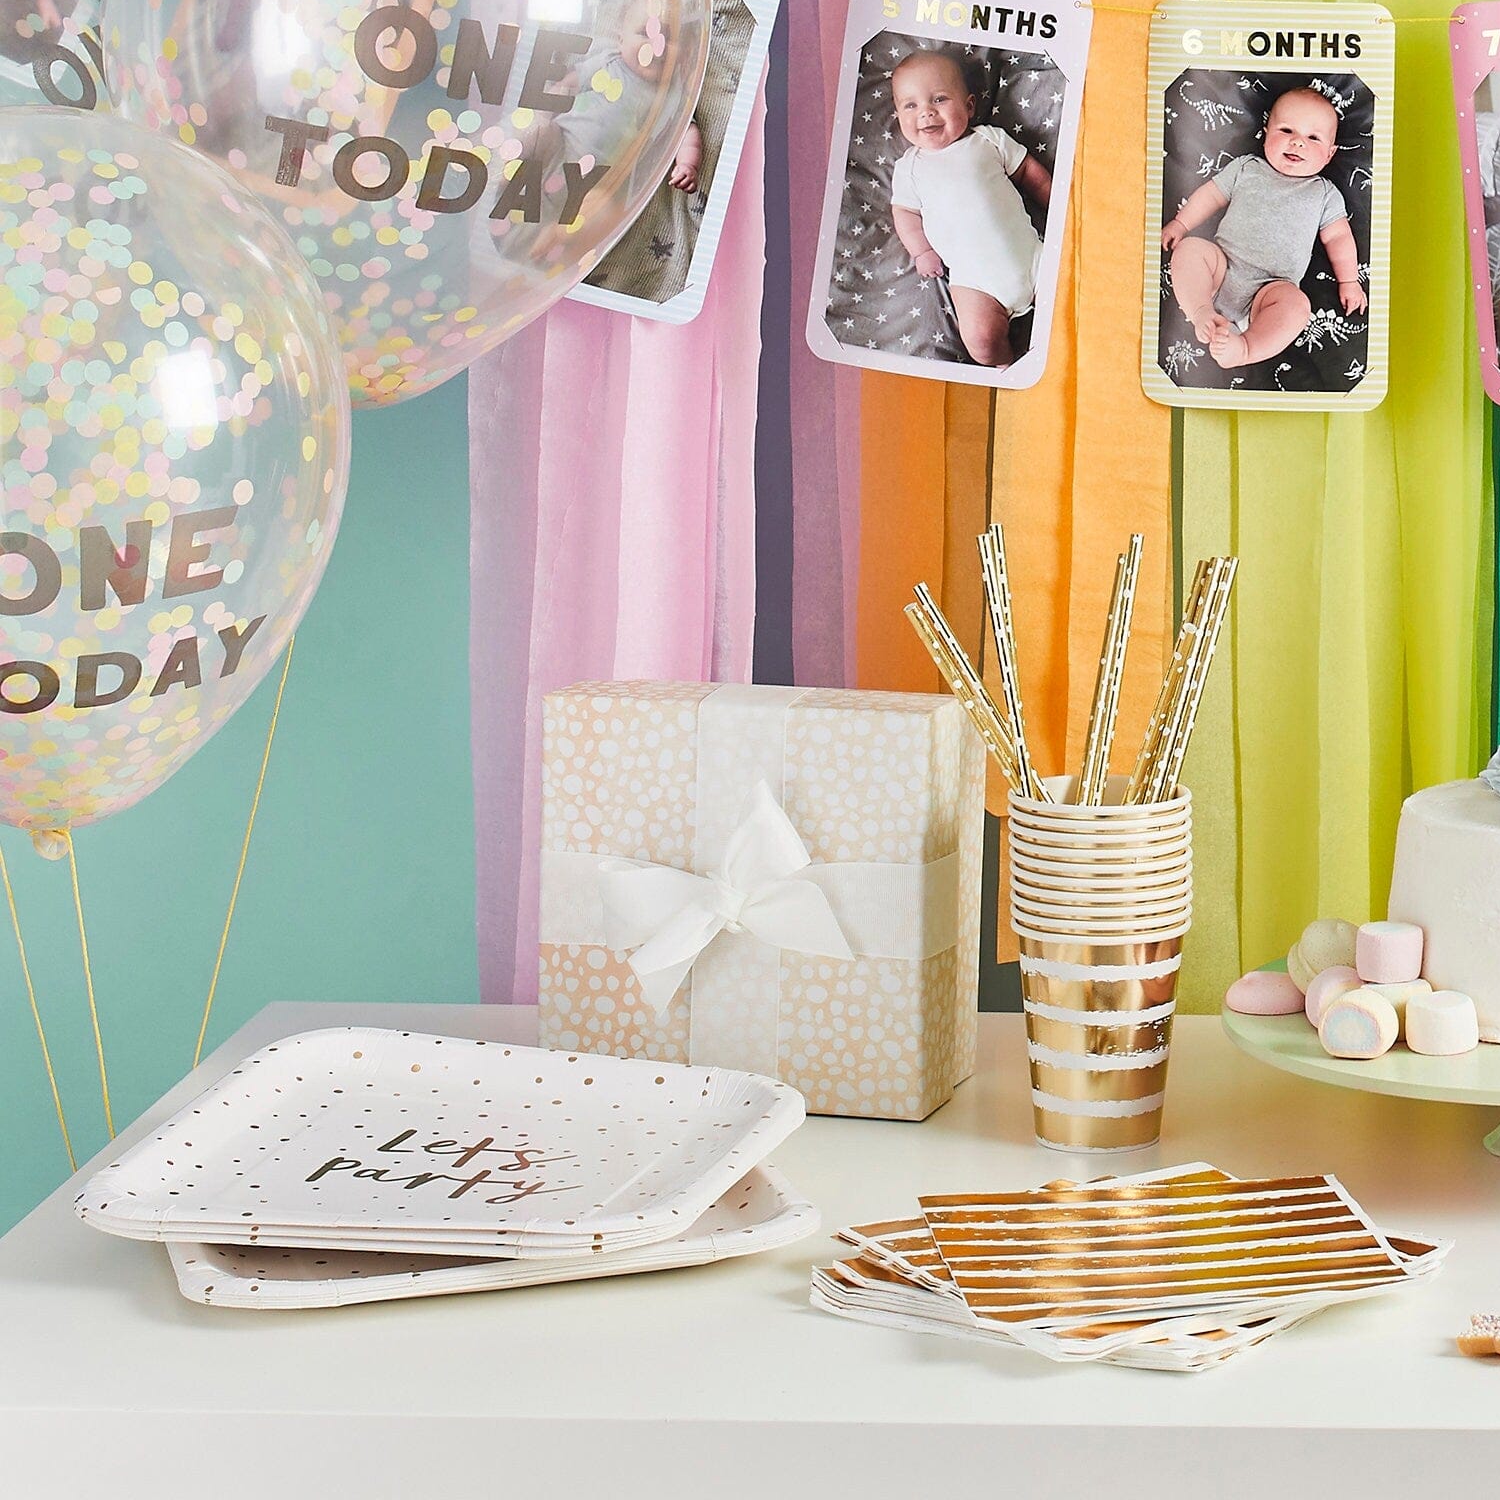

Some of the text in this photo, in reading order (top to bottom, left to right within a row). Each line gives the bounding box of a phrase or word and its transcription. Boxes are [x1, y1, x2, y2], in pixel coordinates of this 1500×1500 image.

[354, 5, 594, 114] ONE
[1182, 29, 1362, 58] 6 MONTHS
[265, 115, 612, 235] TODAY
[377, 1129, 577, 1171] Let's
